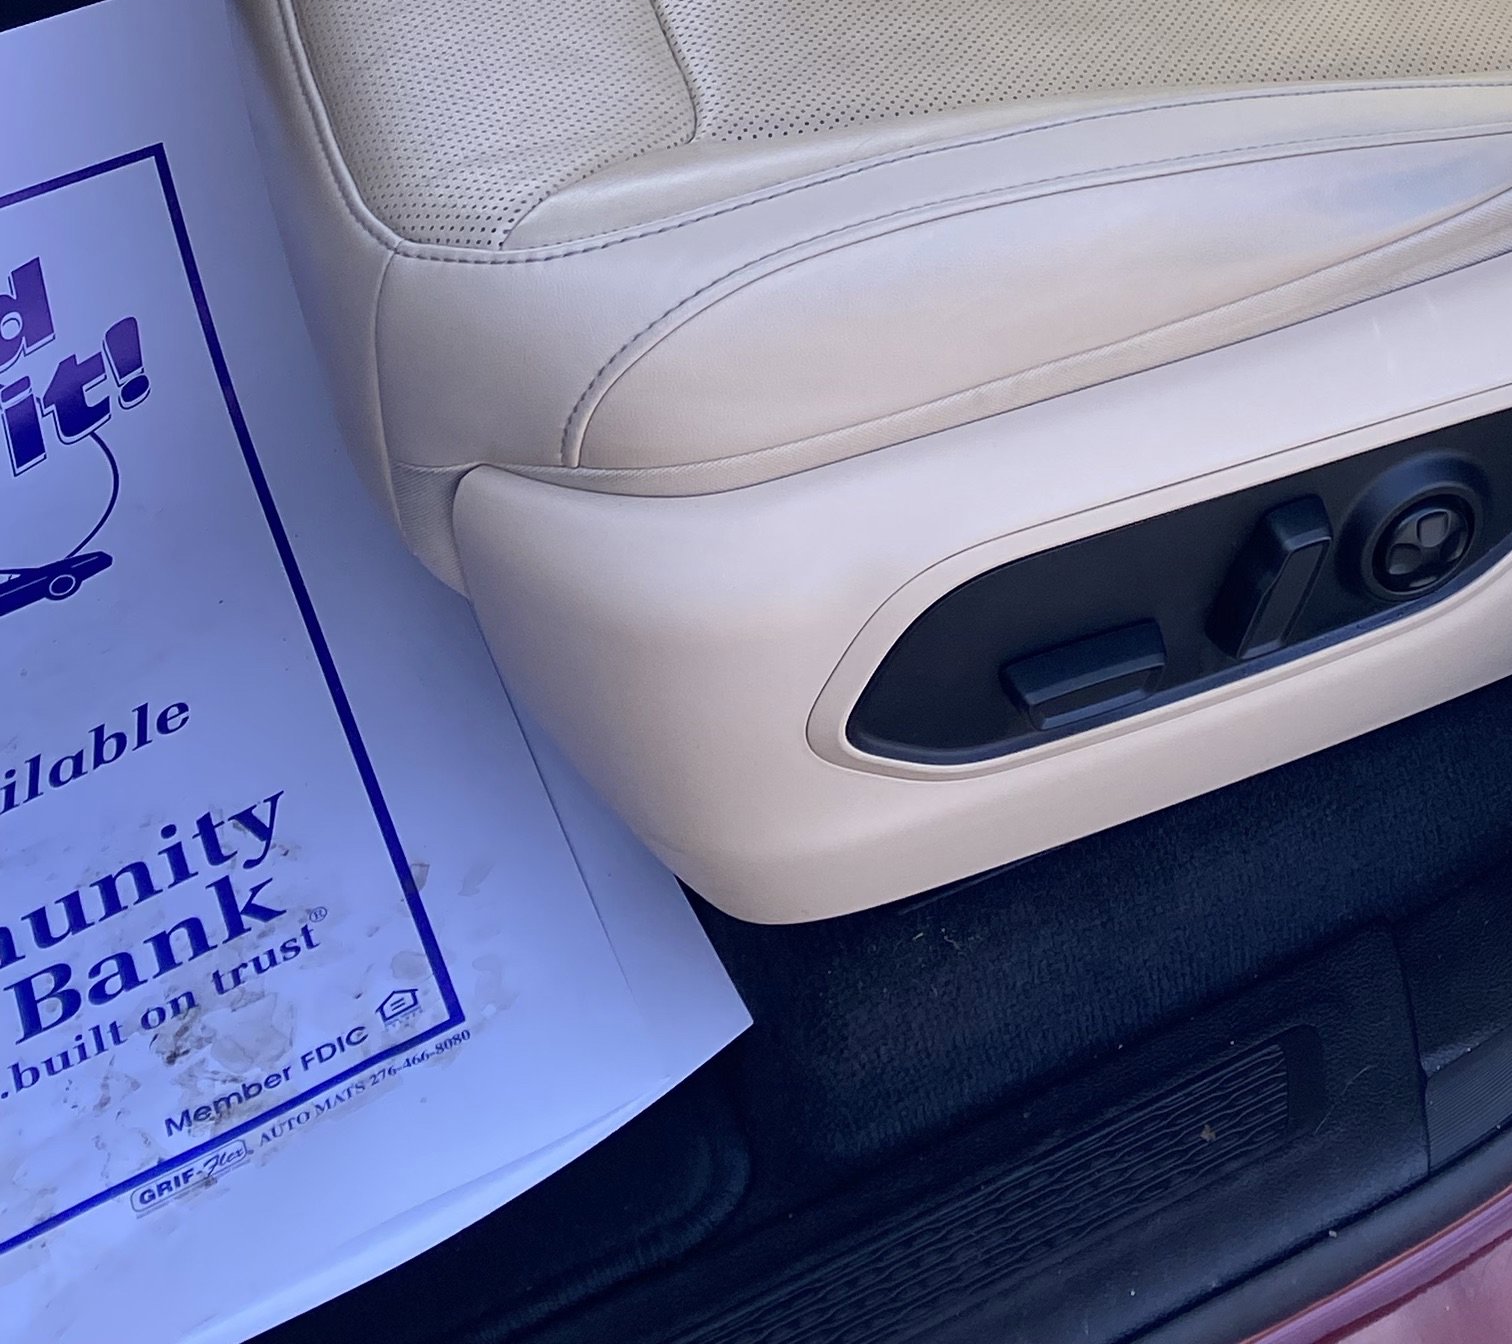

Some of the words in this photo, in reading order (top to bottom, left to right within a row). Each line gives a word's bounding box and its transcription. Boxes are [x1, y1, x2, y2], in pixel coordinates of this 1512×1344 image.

[0, 700, 191, 814] ilable
[3, 874, 288, 1046] Bank
[140, 990, 201, 1032] on
[210, 923, 322, 996] trust
[164, 1065, 292, 1138] Member
[300, 1025, 370, 1073] FDIC
[259, 1110, 311, 1149] AUTO
[314, 1079, 367, 1117] MATS
[368, 1028, 472, 1088] 276-466-8080
